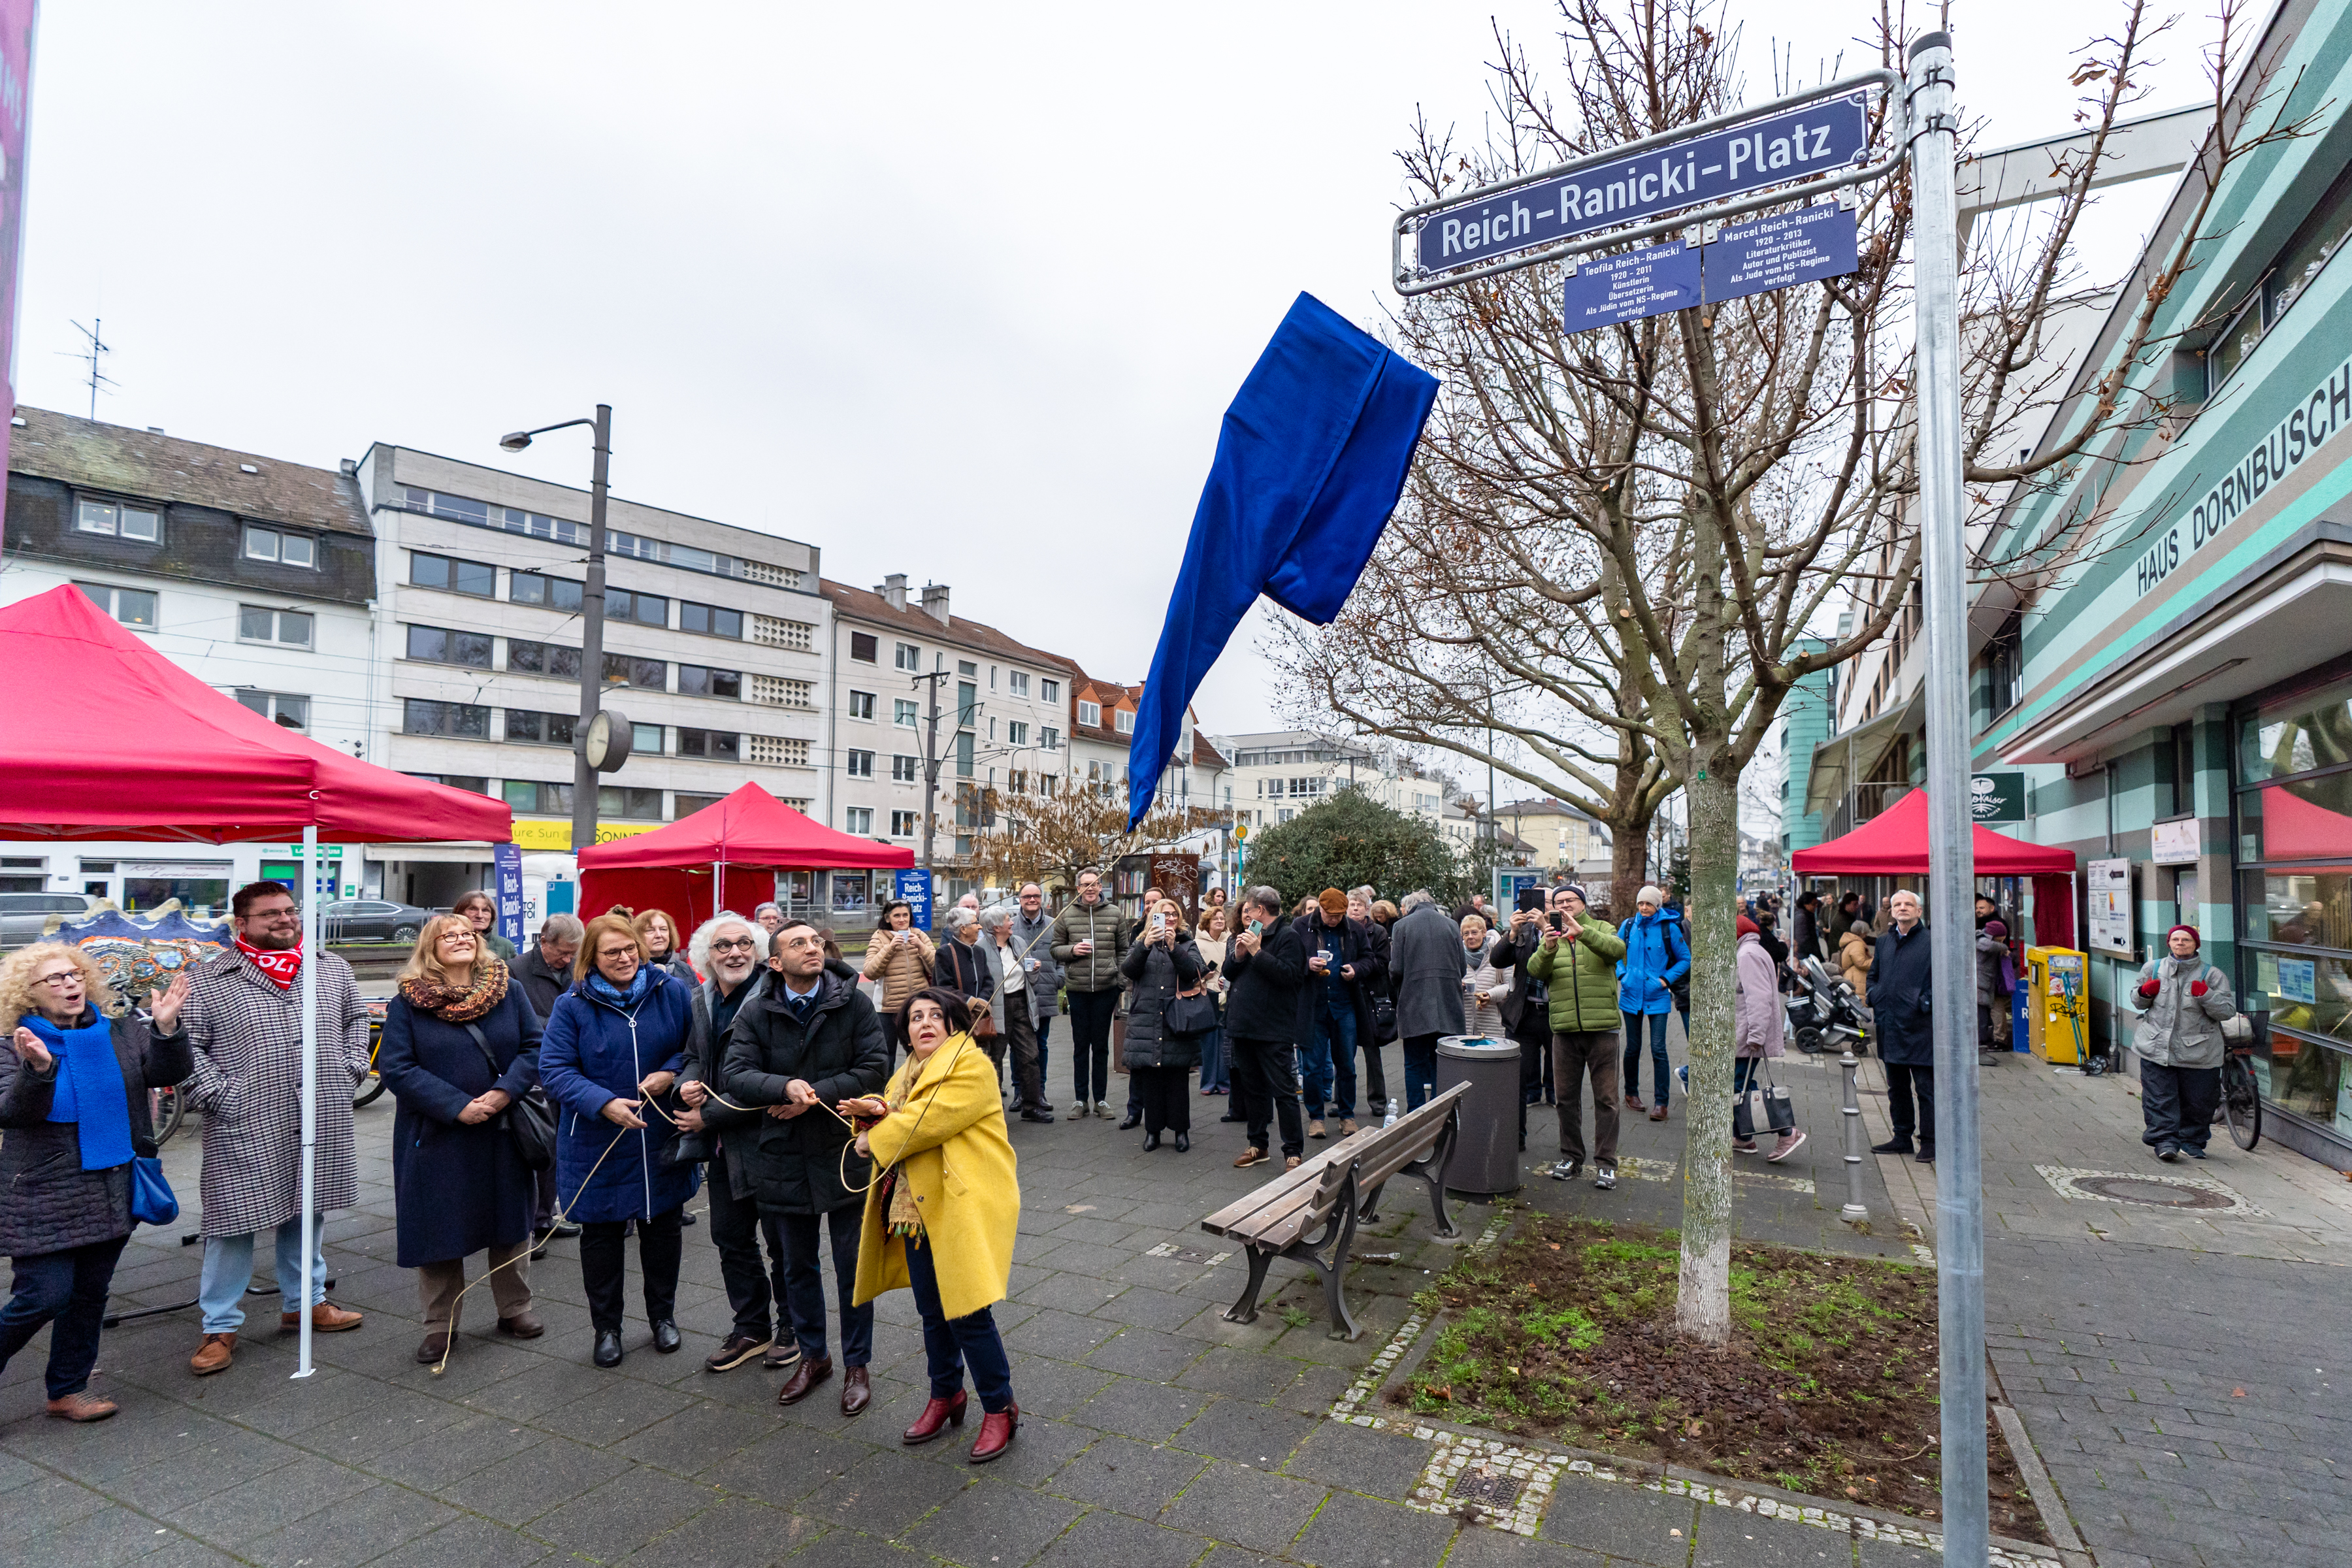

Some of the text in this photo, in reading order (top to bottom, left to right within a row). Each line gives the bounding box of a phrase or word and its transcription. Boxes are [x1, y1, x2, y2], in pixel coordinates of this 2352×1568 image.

[1443, 123, 1831, 257] Reich-Ranicki-Platz
[1725, 207, 1833, 242] Marcel Reich-Ranicki
[1755, 236, 1773, 247] 1920
[1784, 229, 1802, 241] 2013
[1742, 246, 1817, 270] Autor und Publizist
[1746, 238, 1811, 259] Literaturkritiker
[1585, 245, 1679, 276] Teofila Reich-Ranicki
[1730, 255, 1830, 284] Als Jude vom NS-Regime
[1610, 270, 1627, 281] 1920
[1636, 265, 1652, 276] 2011
[1612, 276, 1650, 290] Künstlerin
[1764, 272, 1795, 286] verfolgt
[1599, 302, 1618, 313] Jüdin
[1619, 299, 1634, 308] vom
[1636, 289, 1678, 304] NS-Regime
[1609, 285, 1654, 301] Übersetzerin
[1617, 305, 1646, 318] verfolgt
[2138, 362, 2351, 597] HAUS DORNBUSCH
[512, 828, 559, 838] ure Sun
[504, 874, 519, 894] Reich-
[904, 883, 924, 892] Reich-
[502, 896, 521, 916] Ranicki-
[911, 904, 923, 913] latz
[506, 918, 518, 938] Platz
[1494, 1484, 1510, 1498] GAS
